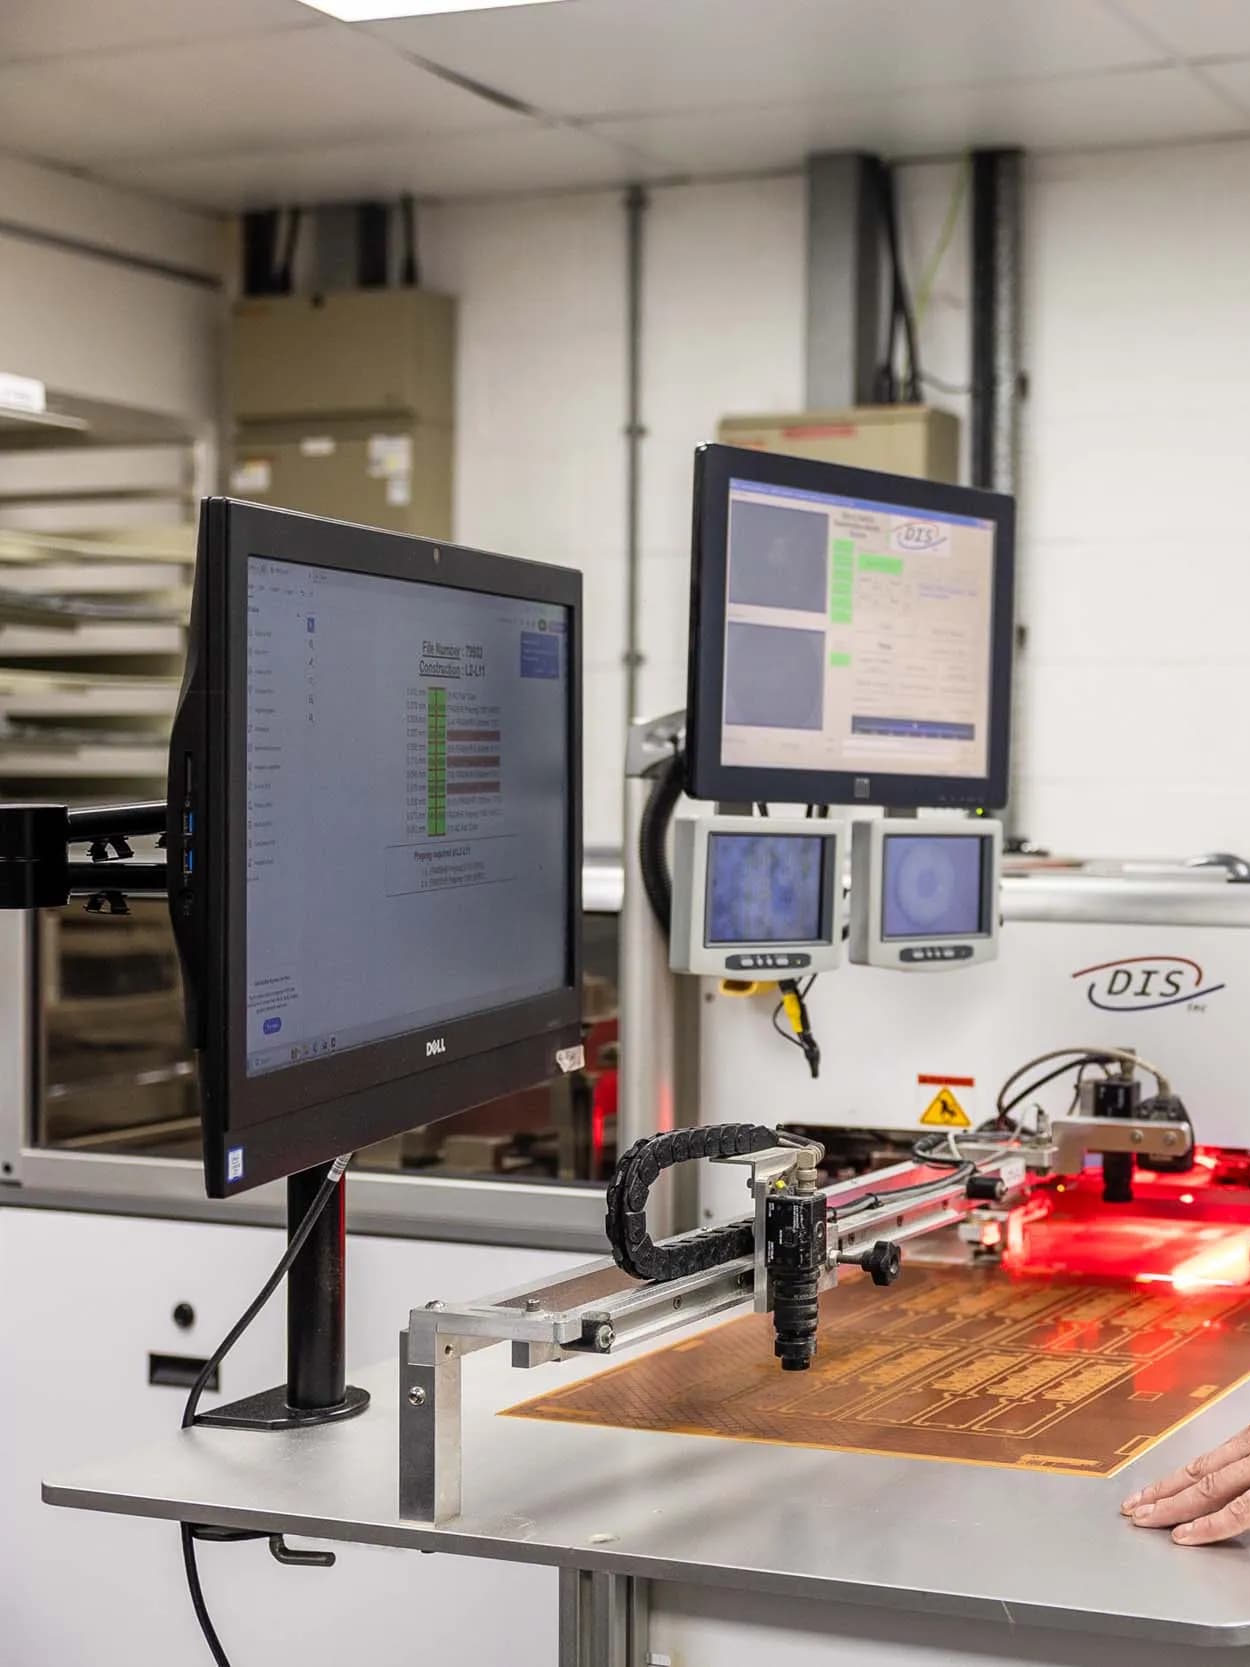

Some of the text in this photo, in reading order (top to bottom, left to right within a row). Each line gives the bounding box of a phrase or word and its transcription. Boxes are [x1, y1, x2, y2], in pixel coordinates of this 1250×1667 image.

[419, 660, 460, 675] Construction
[1107, 968, 1184, 998] DIS
[426, 1038, 446, 1057] DELL
